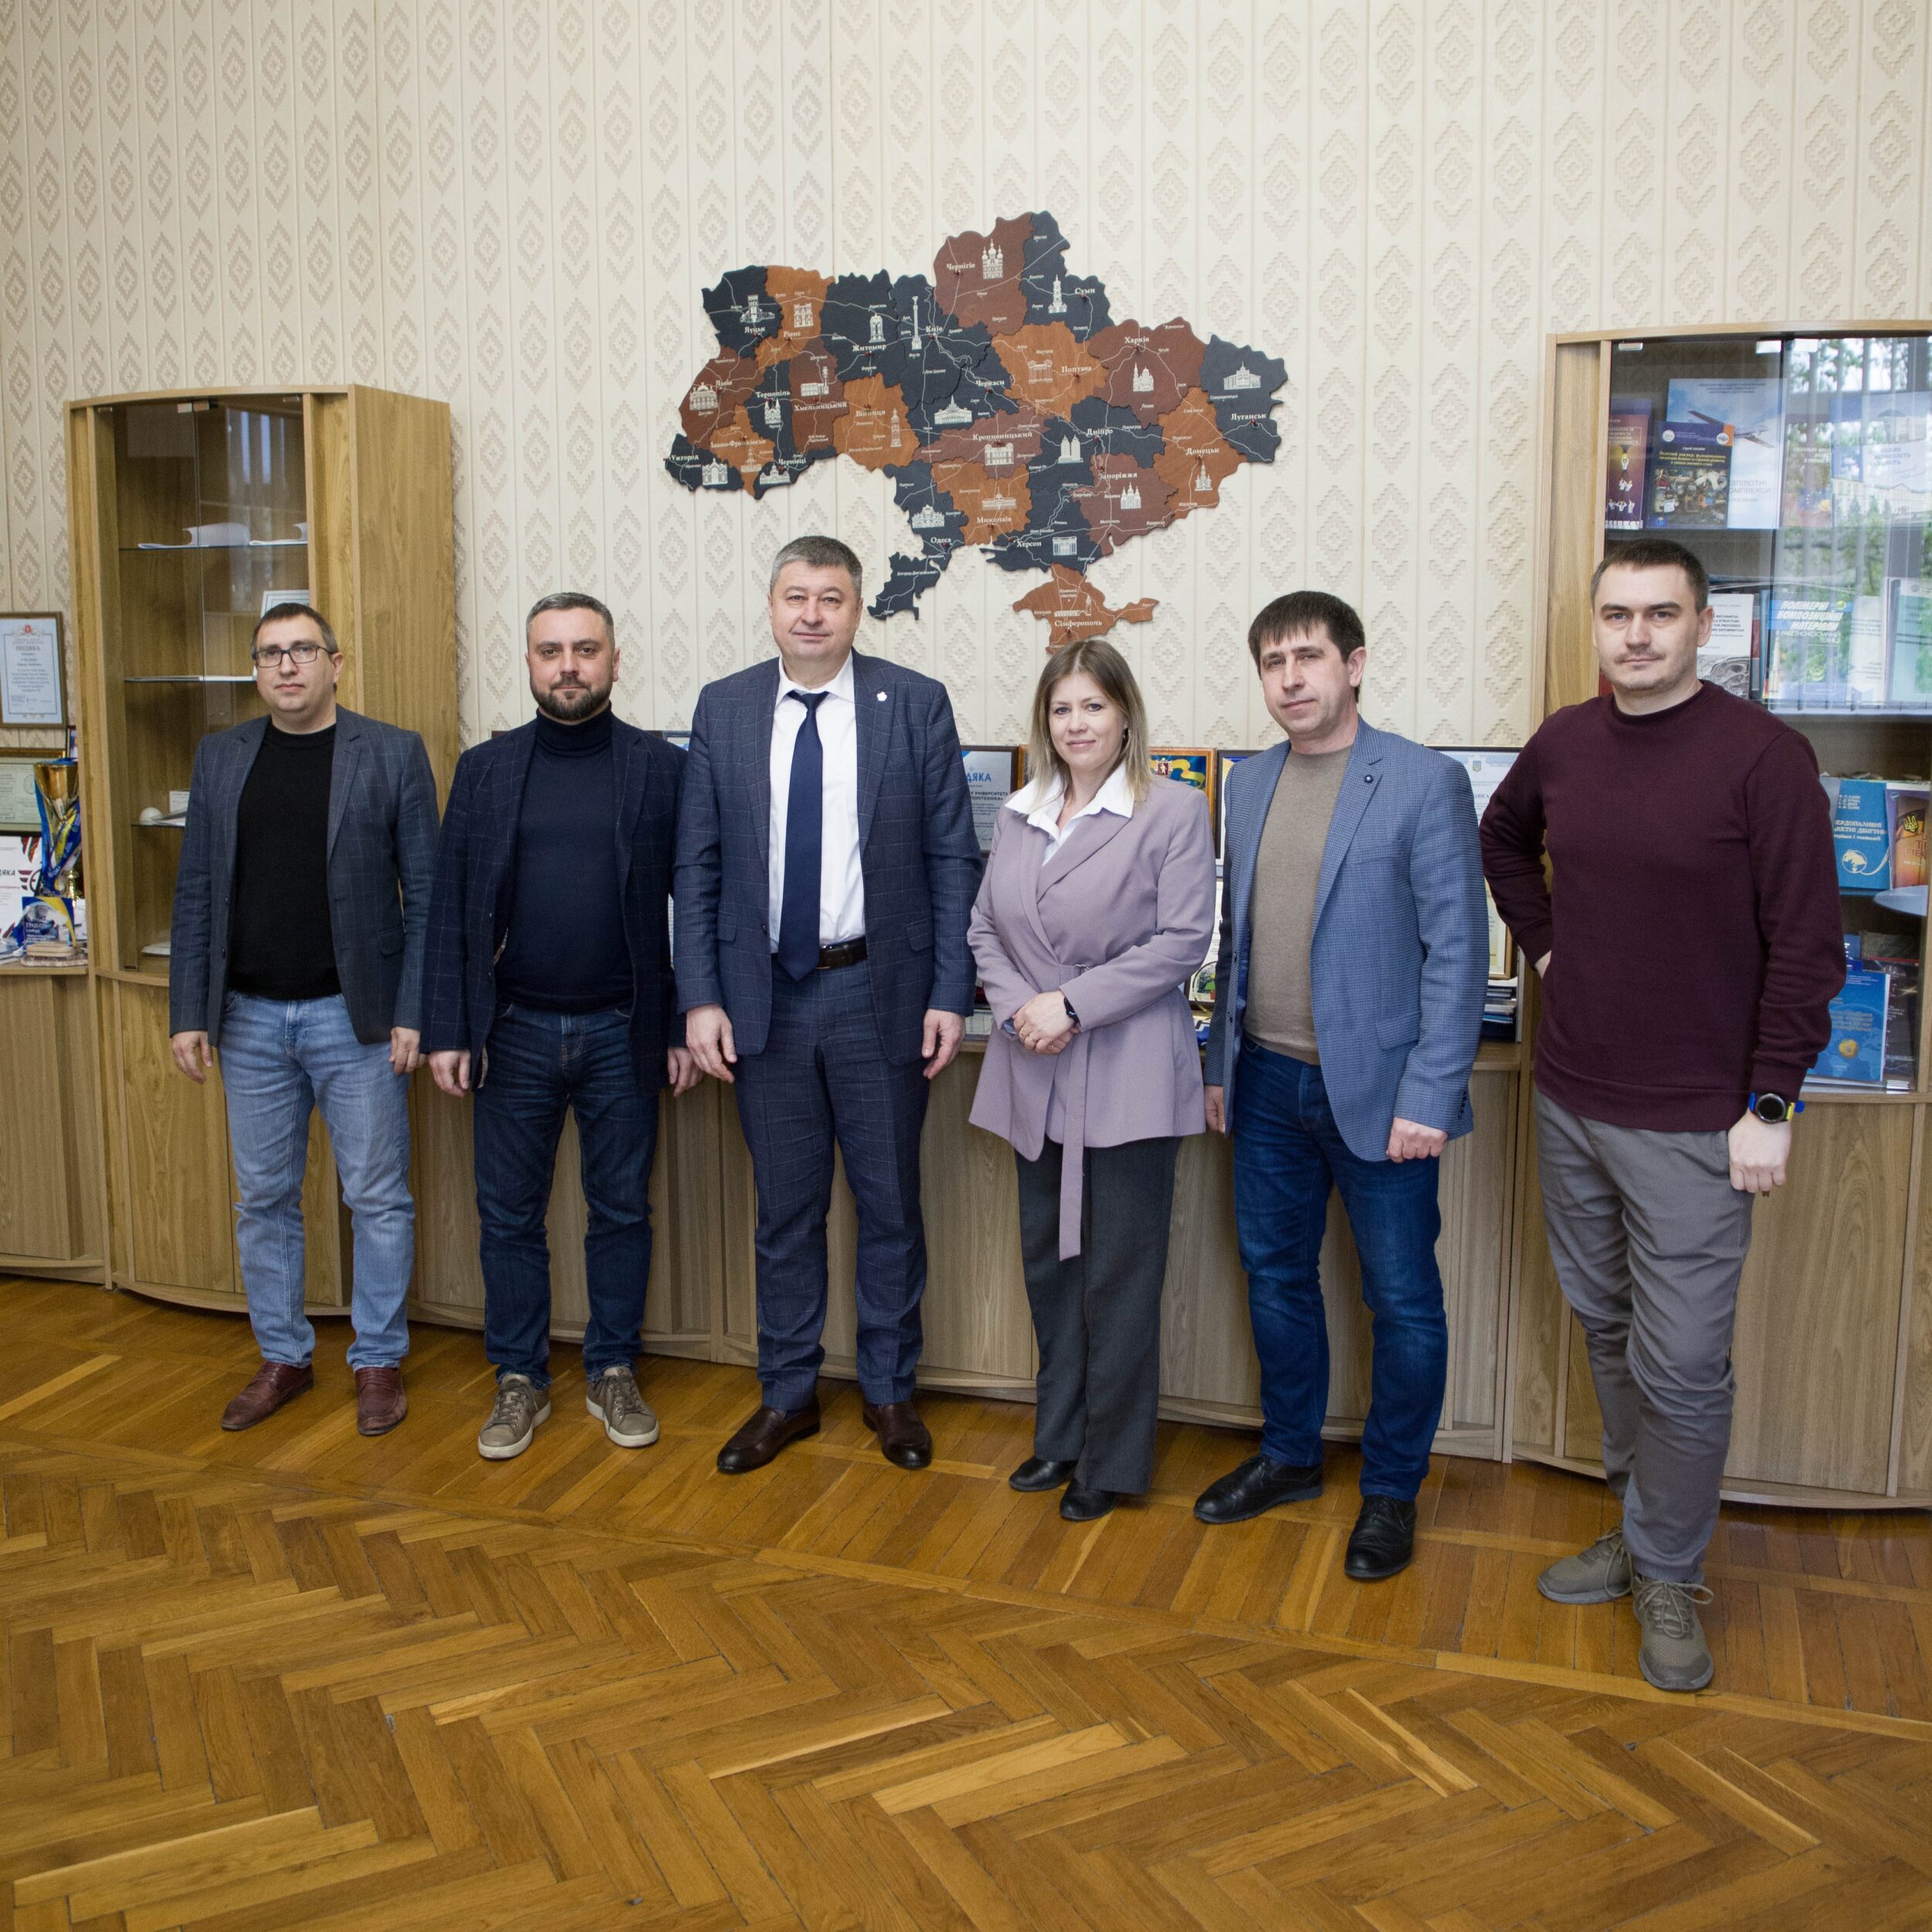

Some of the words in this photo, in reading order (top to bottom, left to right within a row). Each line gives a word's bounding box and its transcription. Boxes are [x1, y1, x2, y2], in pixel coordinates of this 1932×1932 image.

[947, 263, 975, 271] Чернігів
[1075, 287, 1096, 296] Суми
[1124, 335, 1150, 344] Харків
[755, 390, 791, 399] Тернопіль
[794, 402, 848, 412] Хмельницький
[1231, 413, 1267, 421] Луганськ
[1087, 427, 1113, 436] Дніпро
[972, 432, 1032, 441] Кропивницький
[711, 439, 767, 448] Івано-Франківськ
[1186, 447, 1219, 456] Донецьк
[1098, 471, 1138, 480] Запоріжжя
[1781, 600, 1829, 611] ПОЛІМЕРНІ
[1777, 610, 1844, 622] КОМПОЗИЦІЙНІ
[1054, 620, 1102, 628] Сімферополь
[1790, 620, 1839, 631] МАТЕРІАЛИ
[966, 773, 992, 782] ДЯКА
